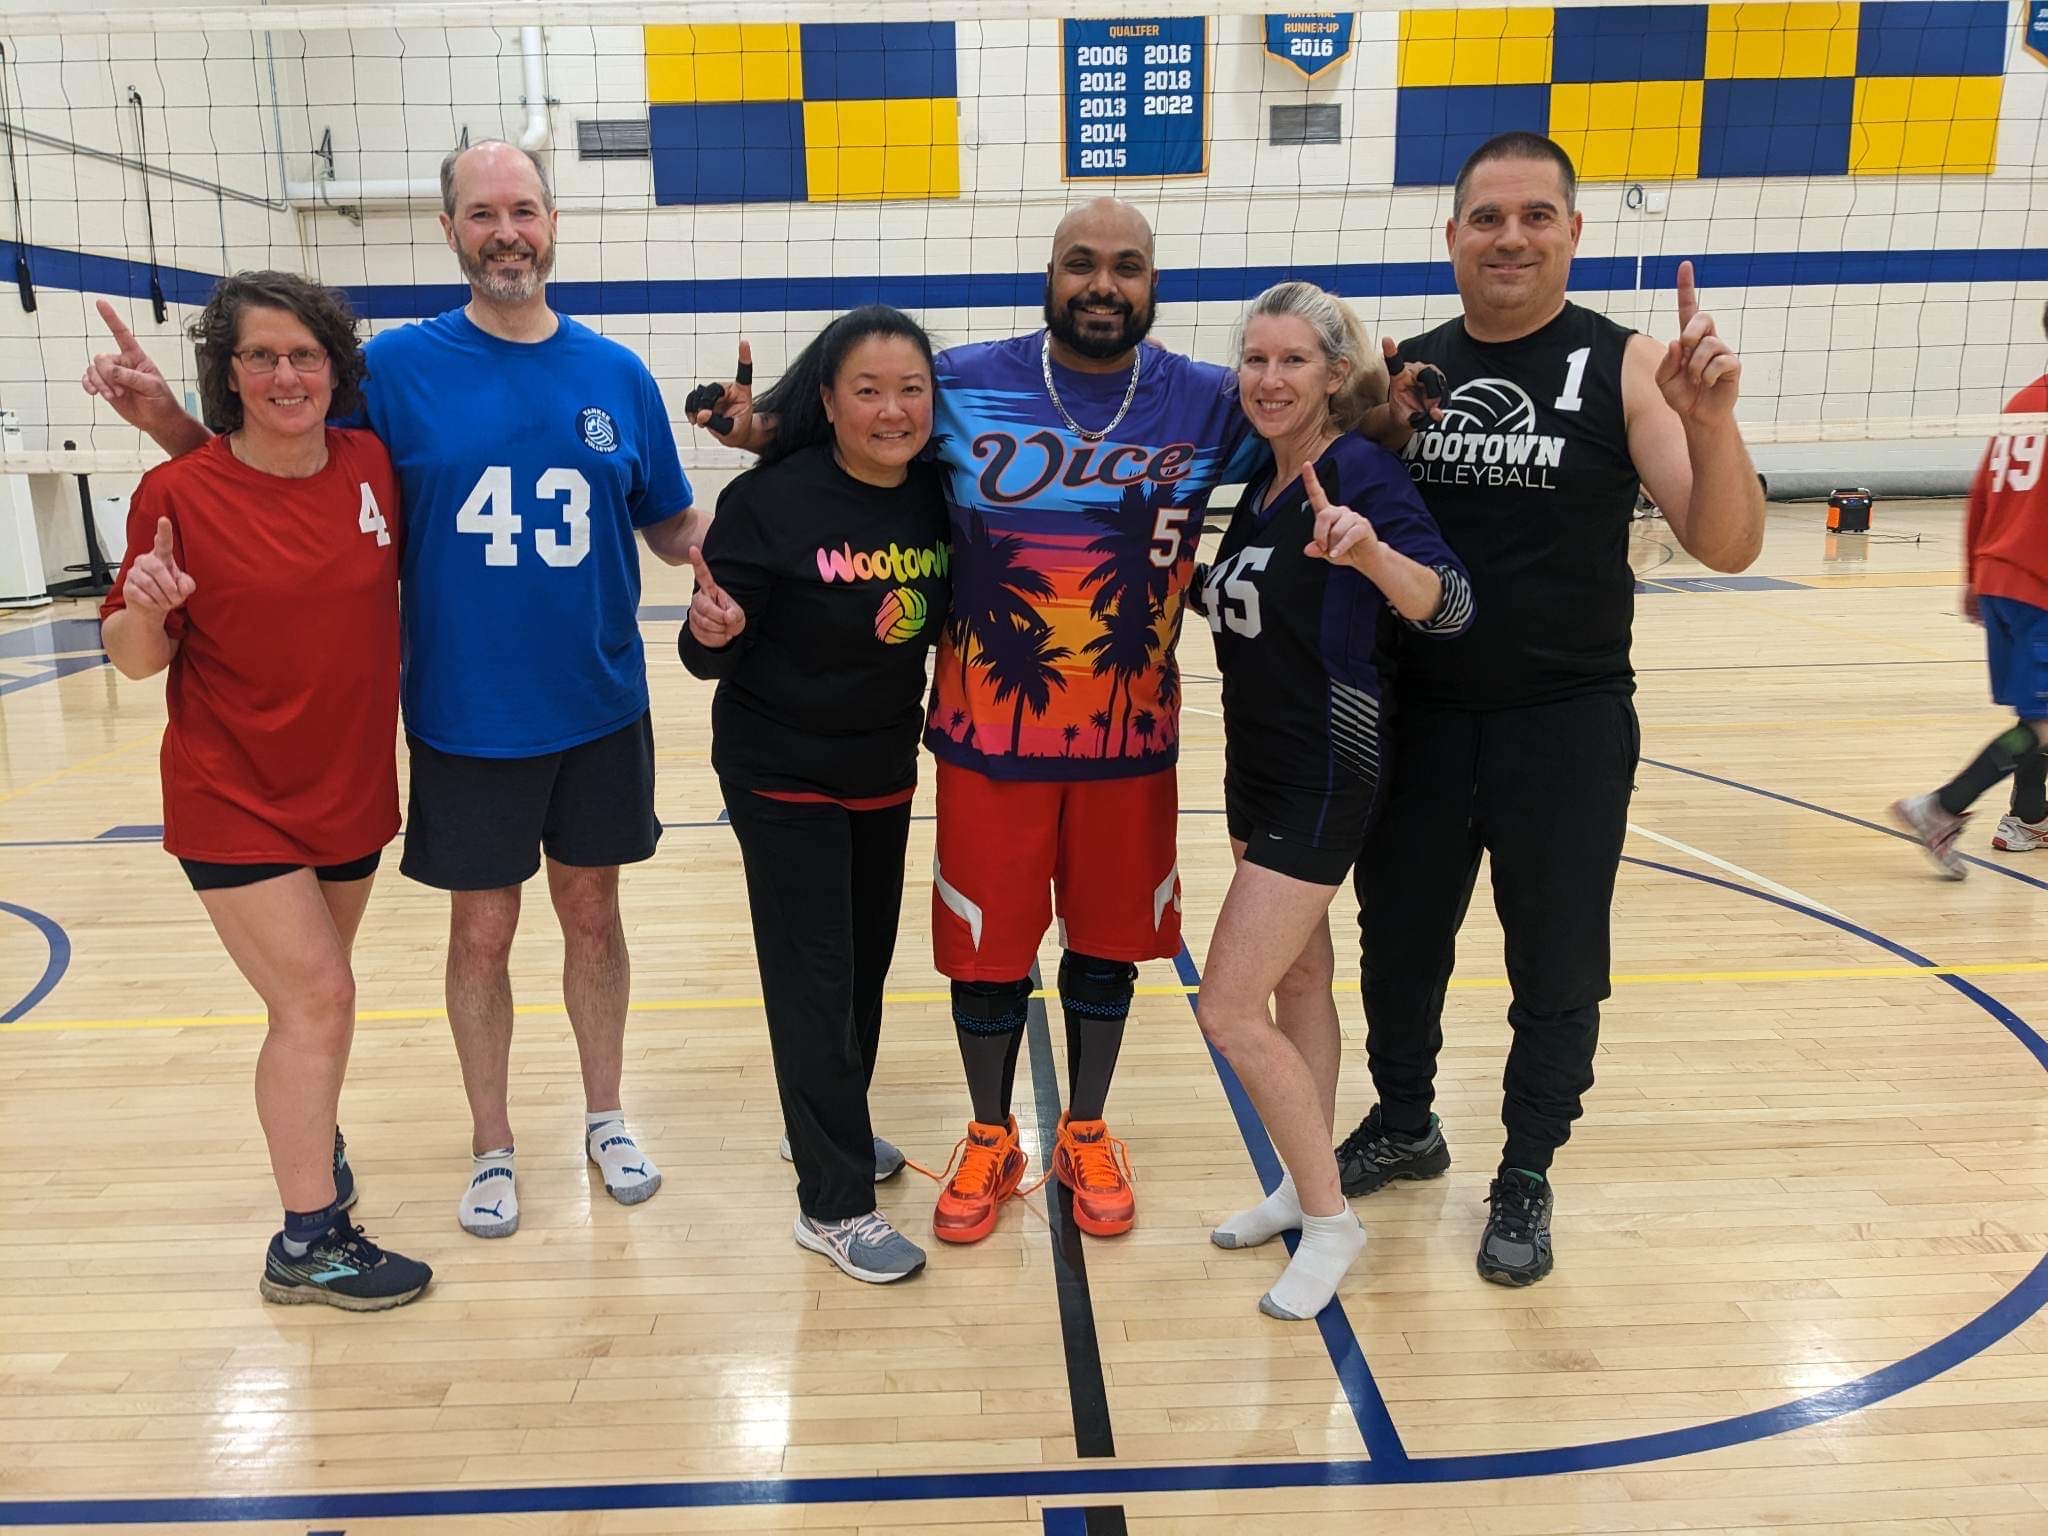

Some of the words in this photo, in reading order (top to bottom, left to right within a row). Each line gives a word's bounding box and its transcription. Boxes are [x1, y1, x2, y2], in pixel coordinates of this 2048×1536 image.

[1109, 25, 1160, 38] QUALIFER
[1284, 23, 1339, 33] RUNNER-UP
[1077, 46, 1128, 66] 2006
[1144, 44, 1192, 64] 2016
[1290, 38, 1334, 57] 2016
[1079, 72, 1126, 92] 2012
[1144, 70, 1191, 91] 2018
[1080, 98, 1126, 118] 2013
[1144, 95, 1193, 116] 2022
[1080, 124, 1126, 143] 2014
[1080, 149, 1126, 169] 2015
[1554, 347, 1591, 412] 1
[972, 431, 1196, 504] Vice
[1406, 462, 1556, 490] OLLEYBALL
[1988, 434, 2047, 493] 49
[358, 481, 392, 547] 4
[456, 465, 591, 568] 43
[1149, 507, 1190, 568] 5
[1201, 545, 1275, 639] 45
